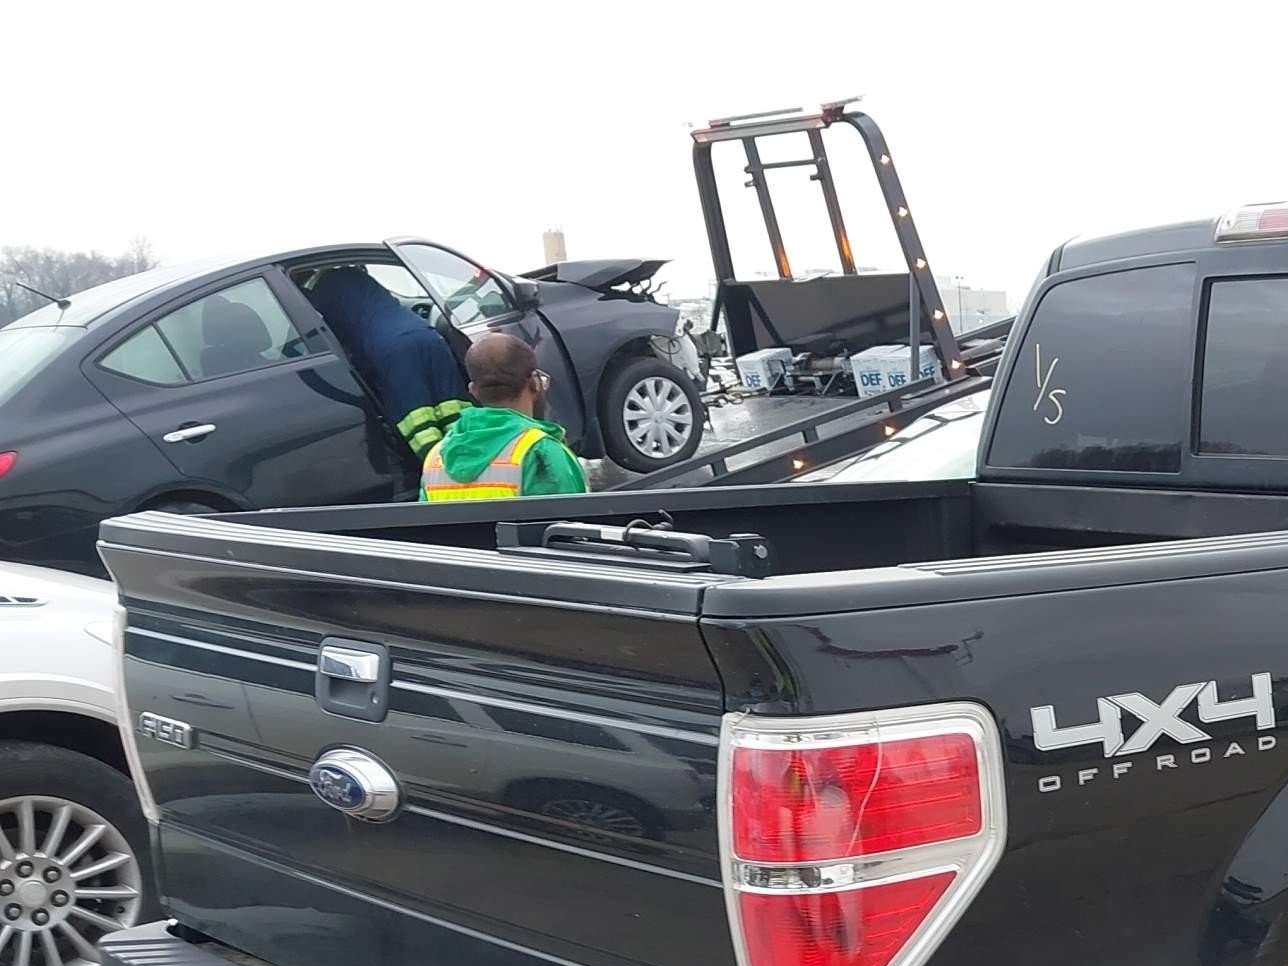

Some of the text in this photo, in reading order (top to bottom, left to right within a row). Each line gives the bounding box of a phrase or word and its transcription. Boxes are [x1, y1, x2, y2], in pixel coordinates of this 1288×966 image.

[860, 372, 882, 388] DEF
[888, 372, 907, 388] DEF
[1038, 735, 1277, 793] OFF ROAD
